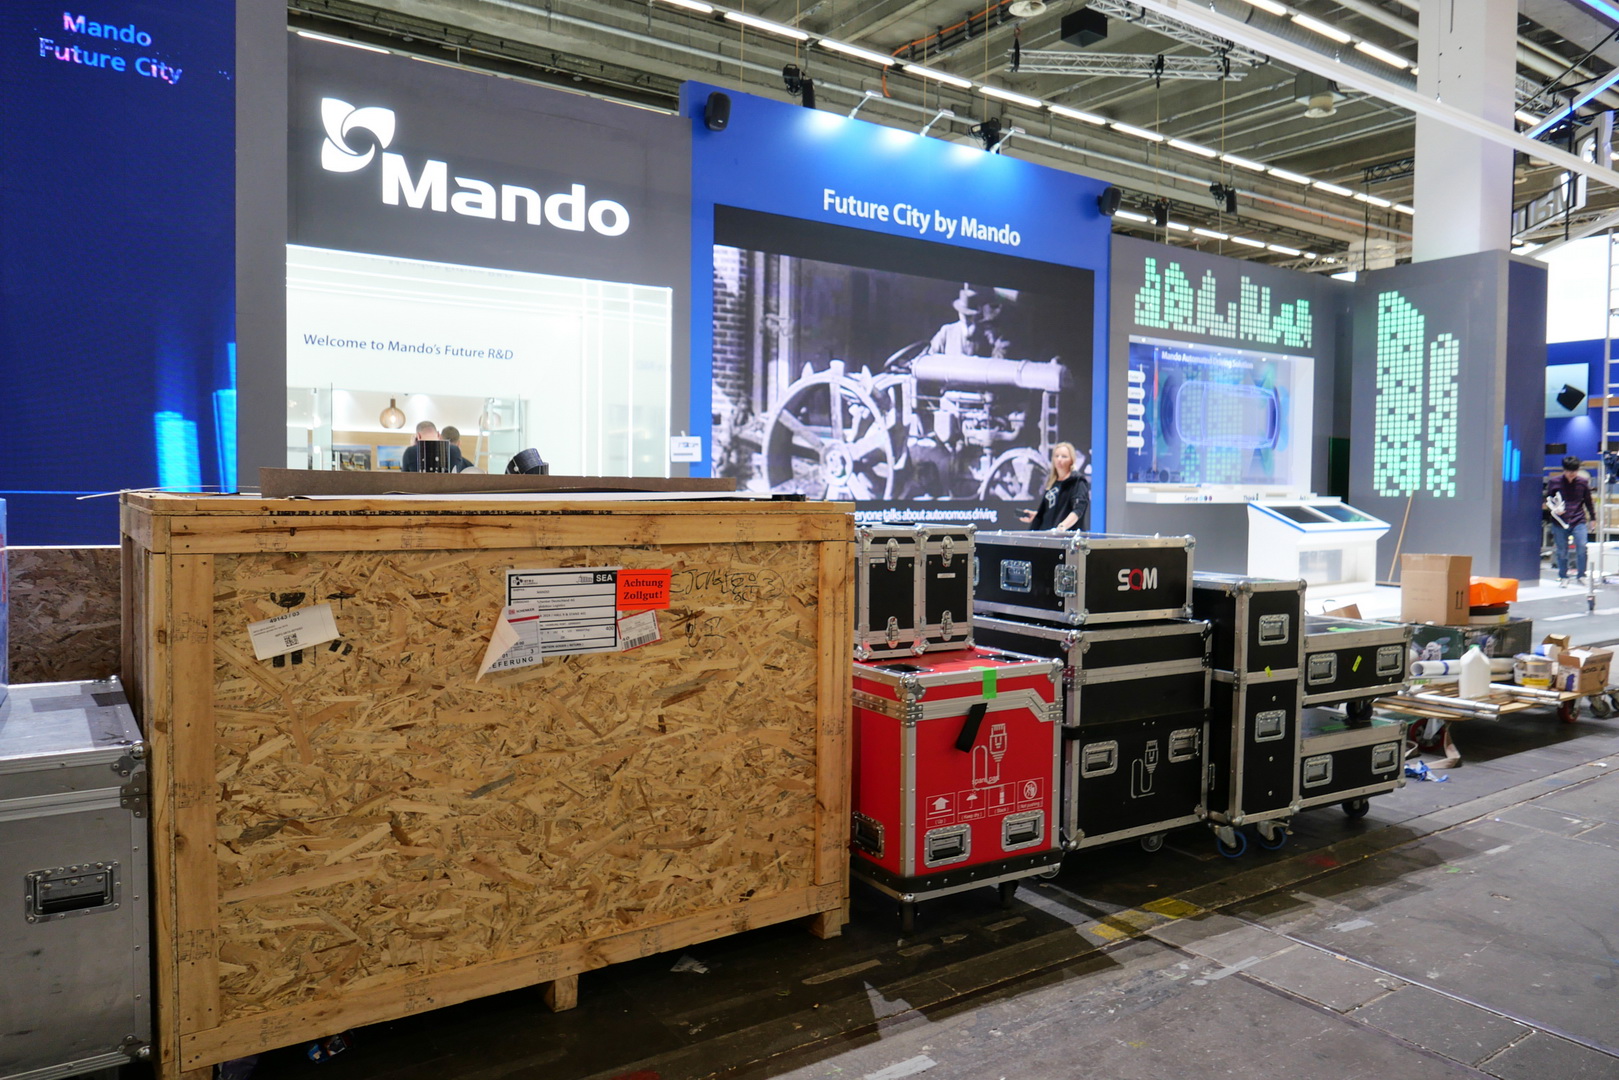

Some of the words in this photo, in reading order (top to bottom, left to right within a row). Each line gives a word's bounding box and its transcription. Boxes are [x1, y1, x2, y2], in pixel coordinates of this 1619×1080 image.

[63, 12, 152, 46] Mando
[39, 37, 126, 72] Future
[135, 56, 183, 85] City
[382, 151, 630, 237] Mando
[823, 188, 889, 222] Future
[893, 203, 931, 235] City
[934, 209, 958, 240] by
[960, 215, 1021, 247] Mando
[303, 333, 367, 349] Welcome
[371, 340, 385, 351] to
[444, 345, 485, 358] Future
[488, 348, 514, 360] R&D
[1161, 351, 1182, 362] Mando
[854, 510, 883, 523] eryone
[883, 508, 902, 521] talks
[901, 508, 926, 521] about
[925, 509, 972, 521] autonomous
[972, 508, 998, 523] driving
[596, 574, 613, 582] SEA
[623, 578, 664, 589] Achtung
[1117, 567, 1158, 592] SOM
[623, 590, 664, 601] Zollgut!
[269, 614, 288, 623] 49143
[489, 656, 534, 669] EFERUNG
